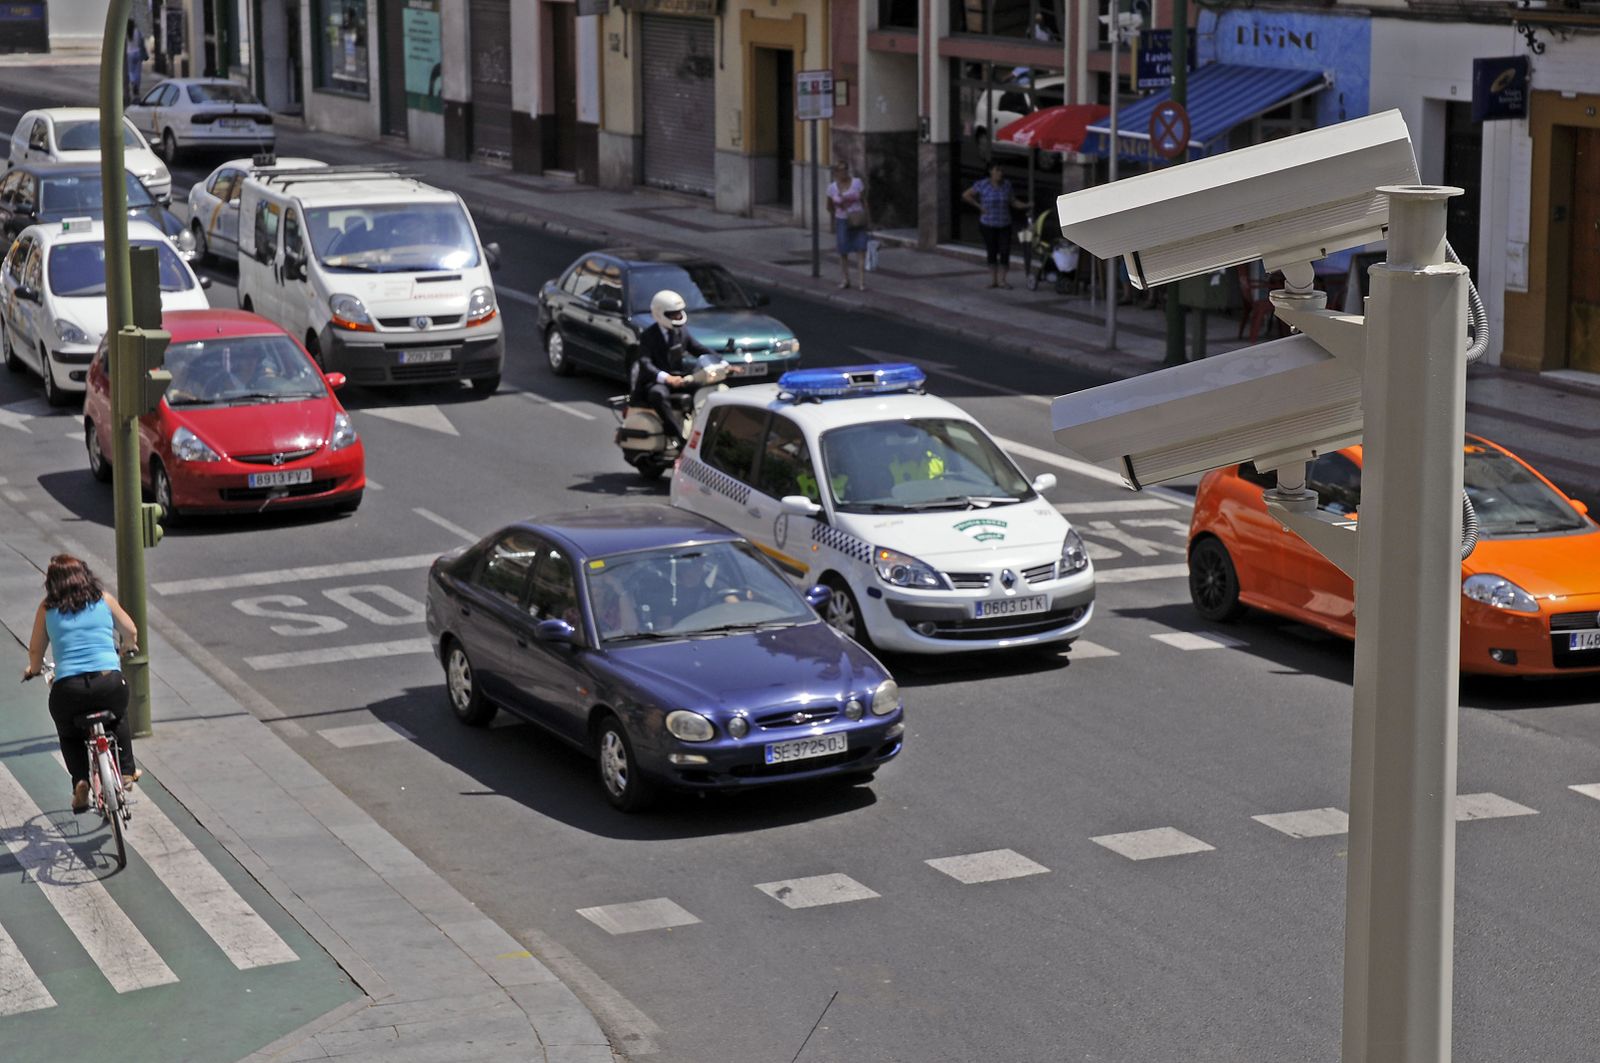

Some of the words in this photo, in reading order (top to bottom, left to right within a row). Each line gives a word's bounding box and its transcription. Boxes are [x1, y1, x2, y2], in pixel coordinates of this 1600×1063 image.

[256, 472, 285, 486] 8913
[984, 600, 1016, 615] 0603
[1020, 598, 1043, 611] GTK
[1581, 633, 1600, 646] 148
